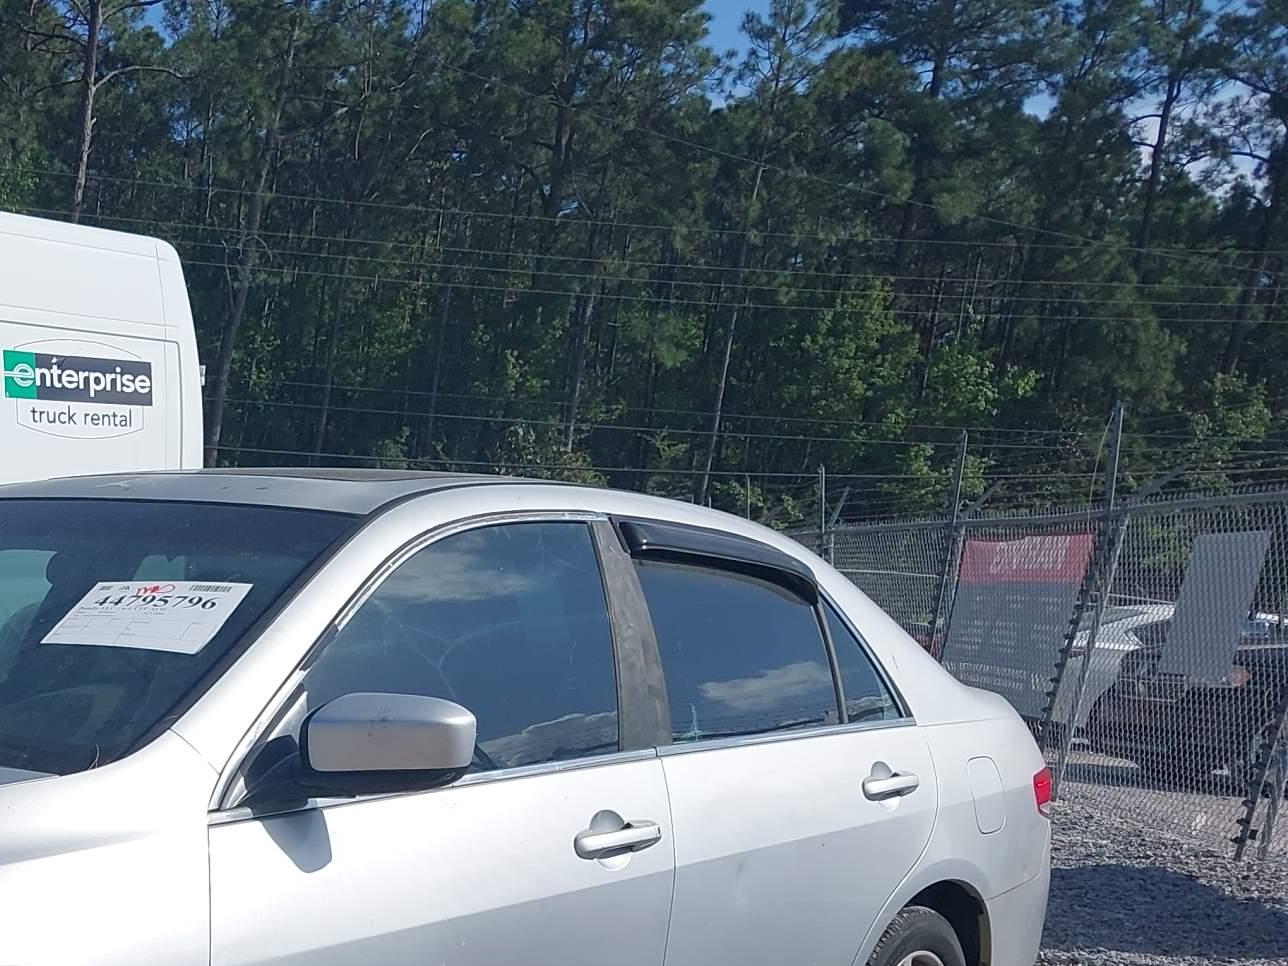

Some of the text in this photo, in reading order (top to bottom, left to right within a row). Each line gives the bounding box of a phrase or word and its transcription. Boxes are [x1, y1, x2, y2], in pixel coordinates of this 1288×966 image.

[10, 357, 151, 397] enterprise
[30, 406, 132, 427] truck rental
[94, 594, 217, 610] 44795796
